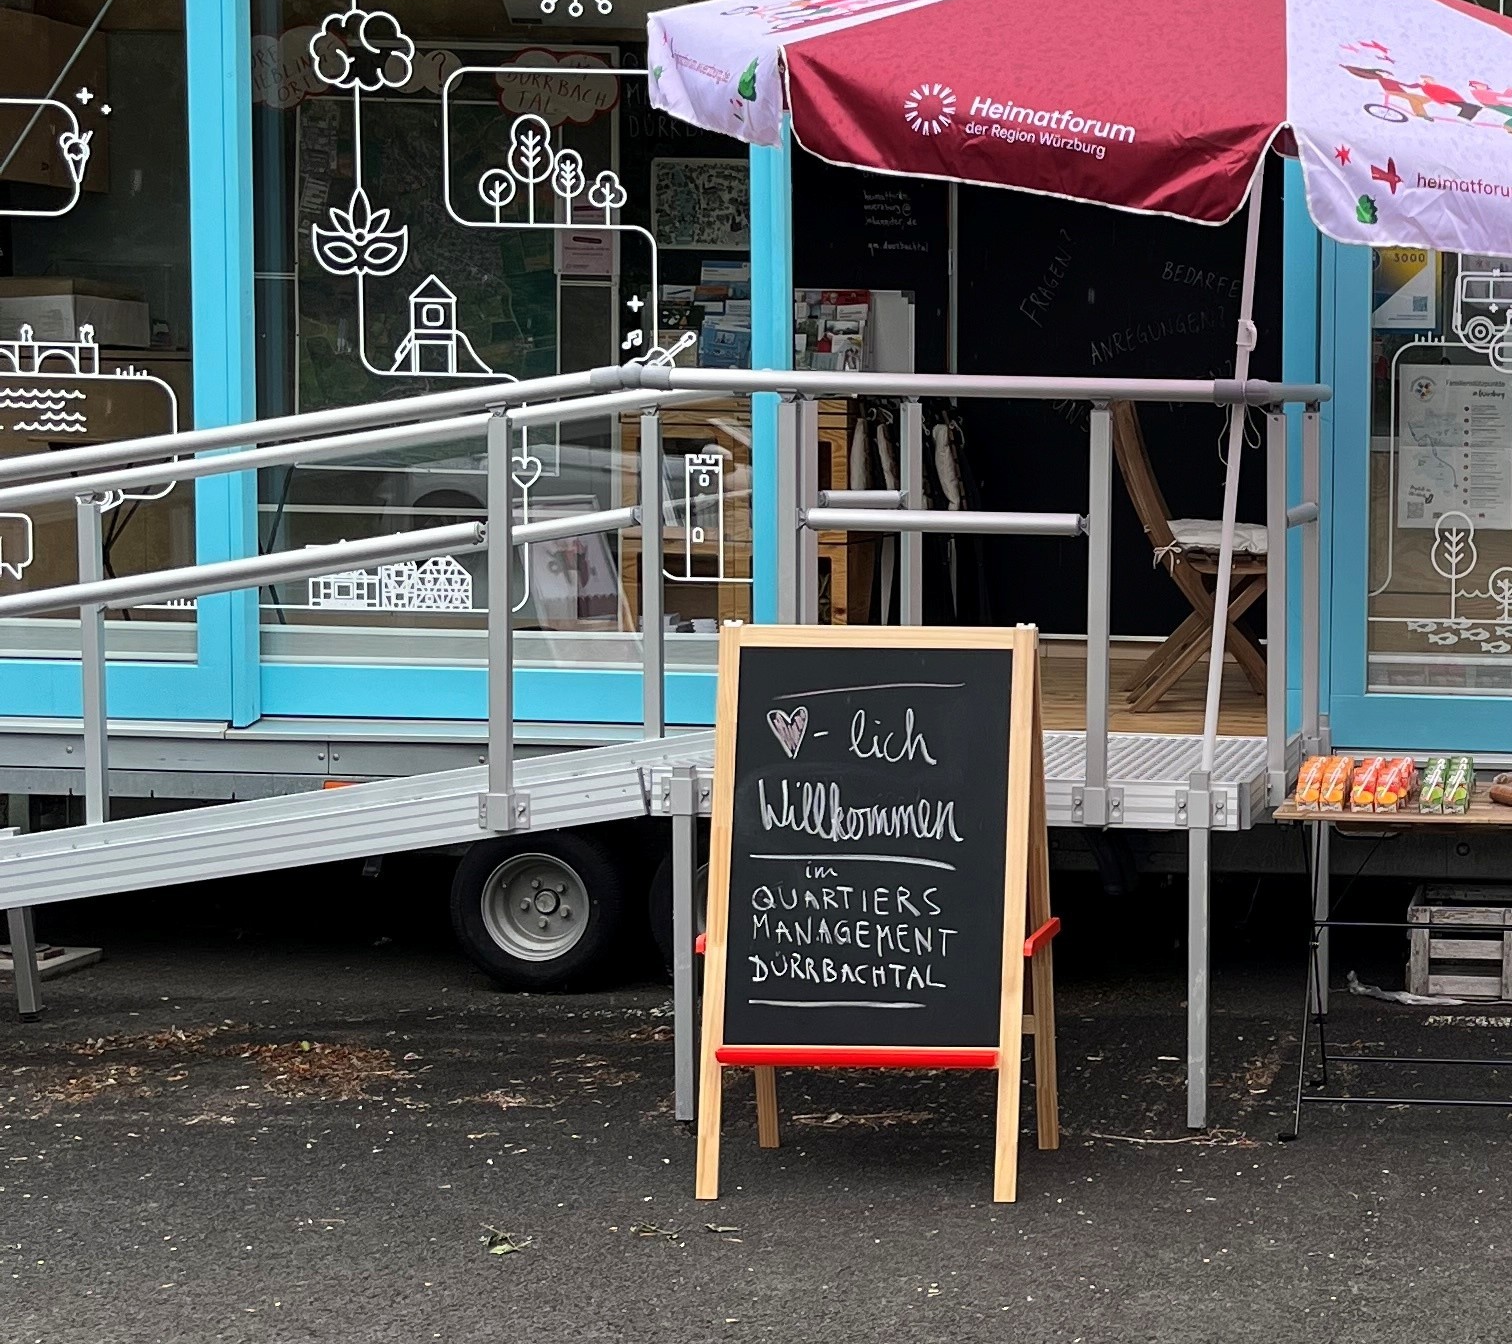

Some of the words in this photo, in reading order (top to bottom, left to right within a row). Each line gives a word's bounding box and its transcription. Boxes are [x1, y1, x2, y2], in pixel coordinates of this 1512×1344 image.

[965, 121, 989, 136] der
[991, 123, 1036, 144] Region
[1039, 131, 1106, 159] Würzburg
[969, 95, 1136, 144] Heimatforum
[848, 707, 938, 765] lich
[758, 778, 964, 843] Willkommen
[805, 860, 838, 879] im
[751, 885, 943, 916] QUARTIERS
[752, 914, 958, 957] MANAGEMENT
